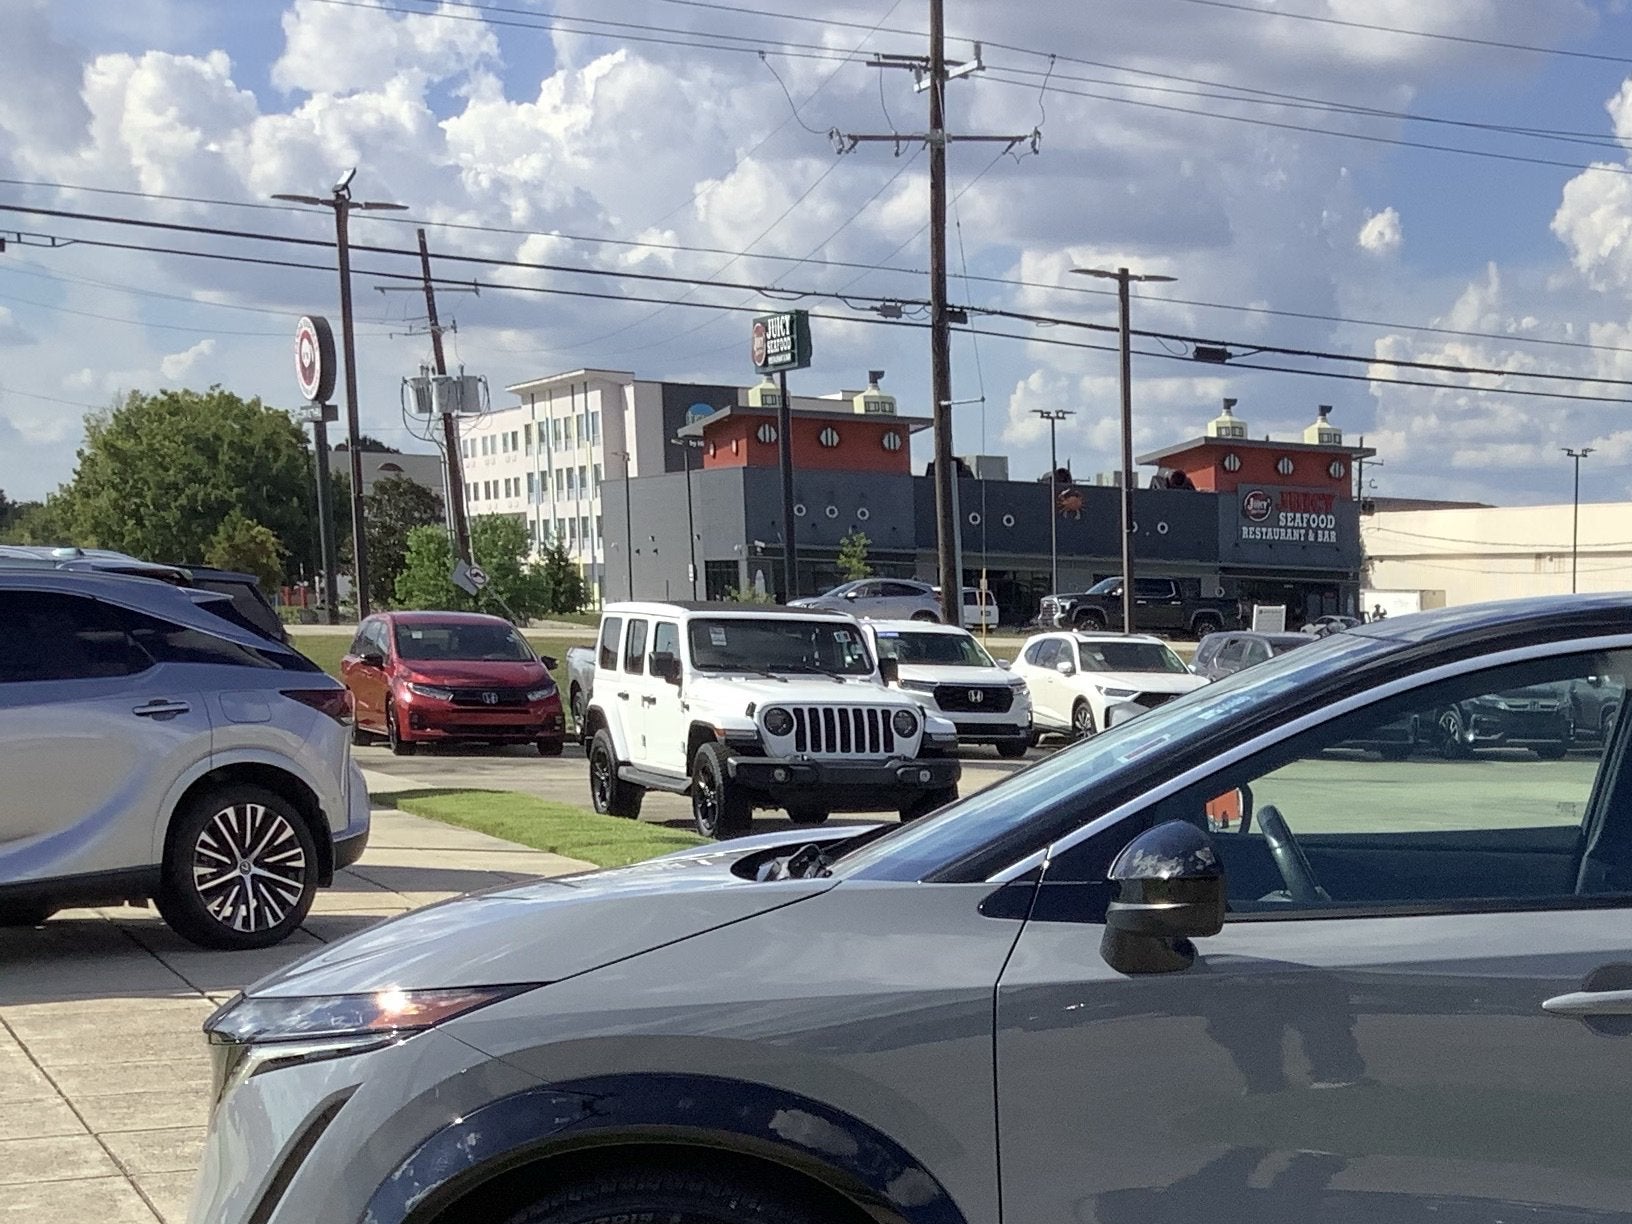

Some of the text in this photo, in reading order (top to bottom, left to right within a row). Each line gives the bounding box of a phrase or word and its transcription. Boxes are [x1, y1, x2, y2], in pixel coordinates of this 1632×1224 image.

[766, 315, 790, 339] JUICY
[767, 336, 791, 354] SEAFOOD
[1279, 512, 1335, 528] SEAFOOD
[1242, 526, 1337, 542] RESTAURANT & BAR
